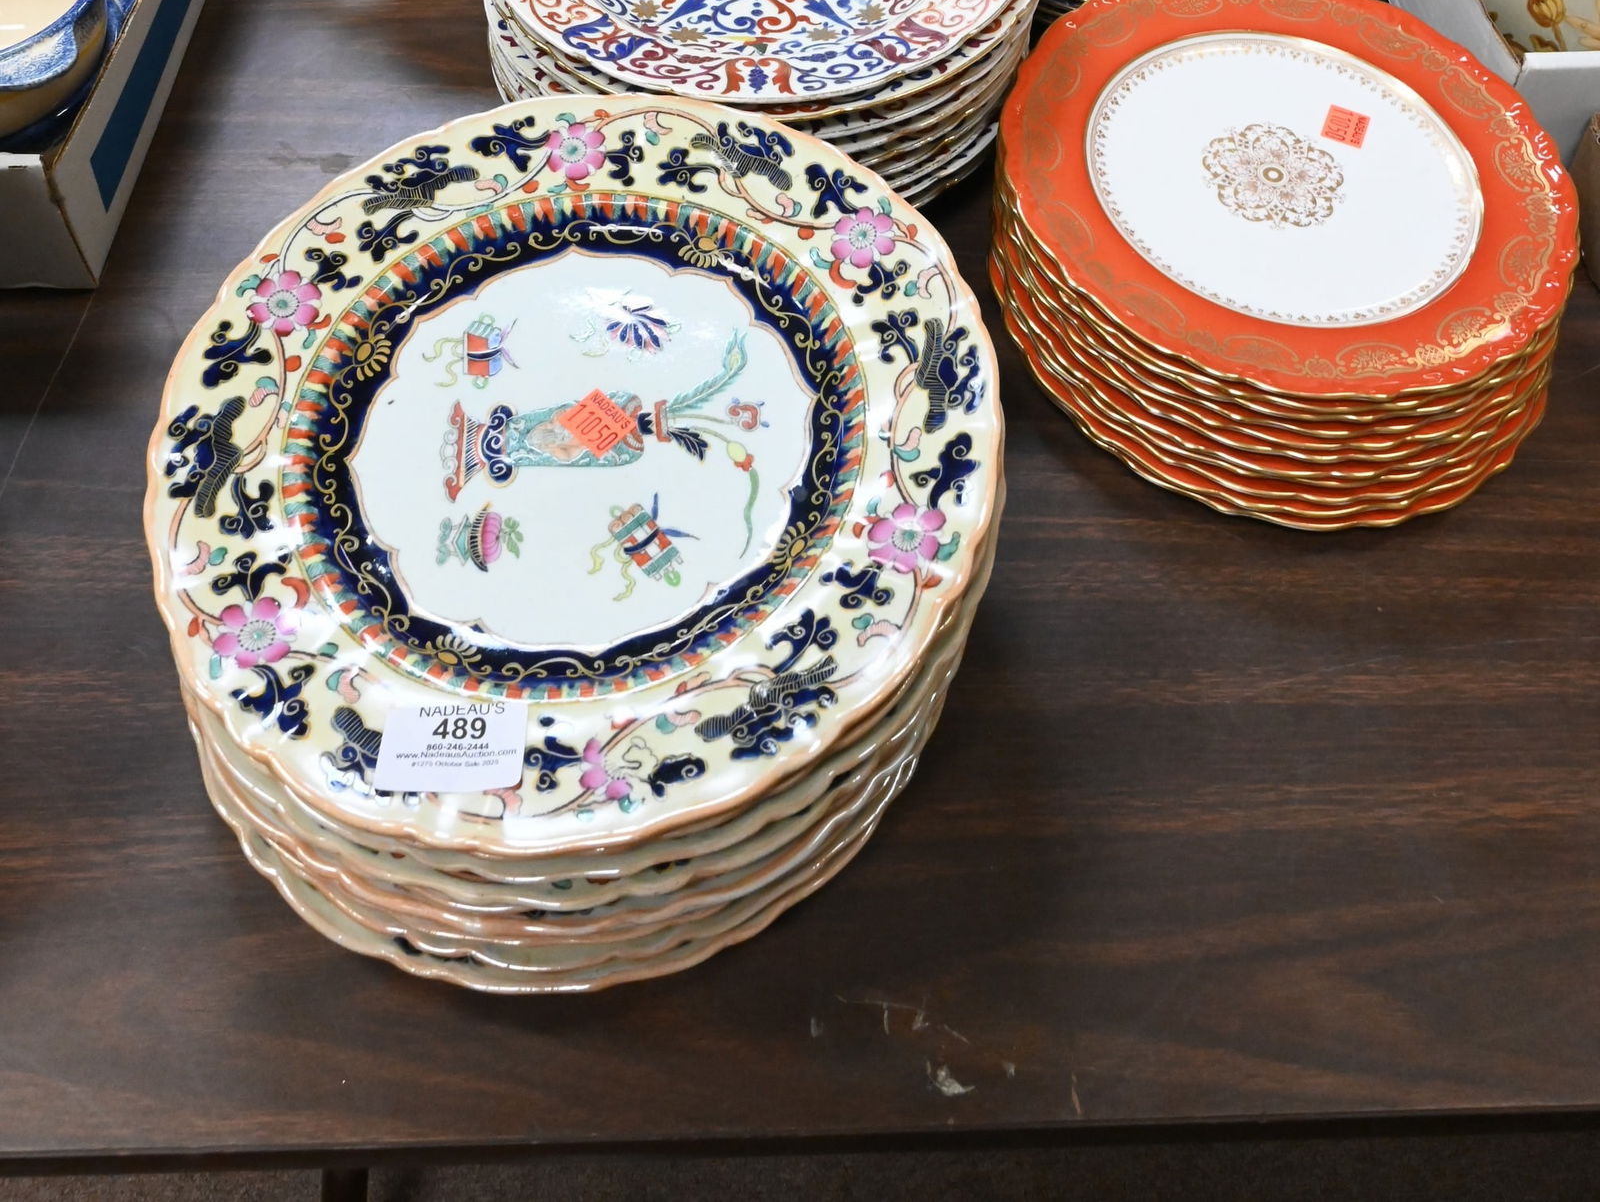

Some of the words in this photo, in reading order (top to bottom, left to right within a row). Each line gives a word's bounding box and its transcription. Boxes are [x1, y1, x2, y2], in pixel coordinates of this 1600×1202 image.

[590, 393, 631, 430] NADEAU'S
[419, 702, 505, 718] NADEAU'S
[432, 717, 487, 740] 489
[396, 748, 517, 759] www.NadeausAuction.com
[426, 742, 489, 751] 860-246-2444
